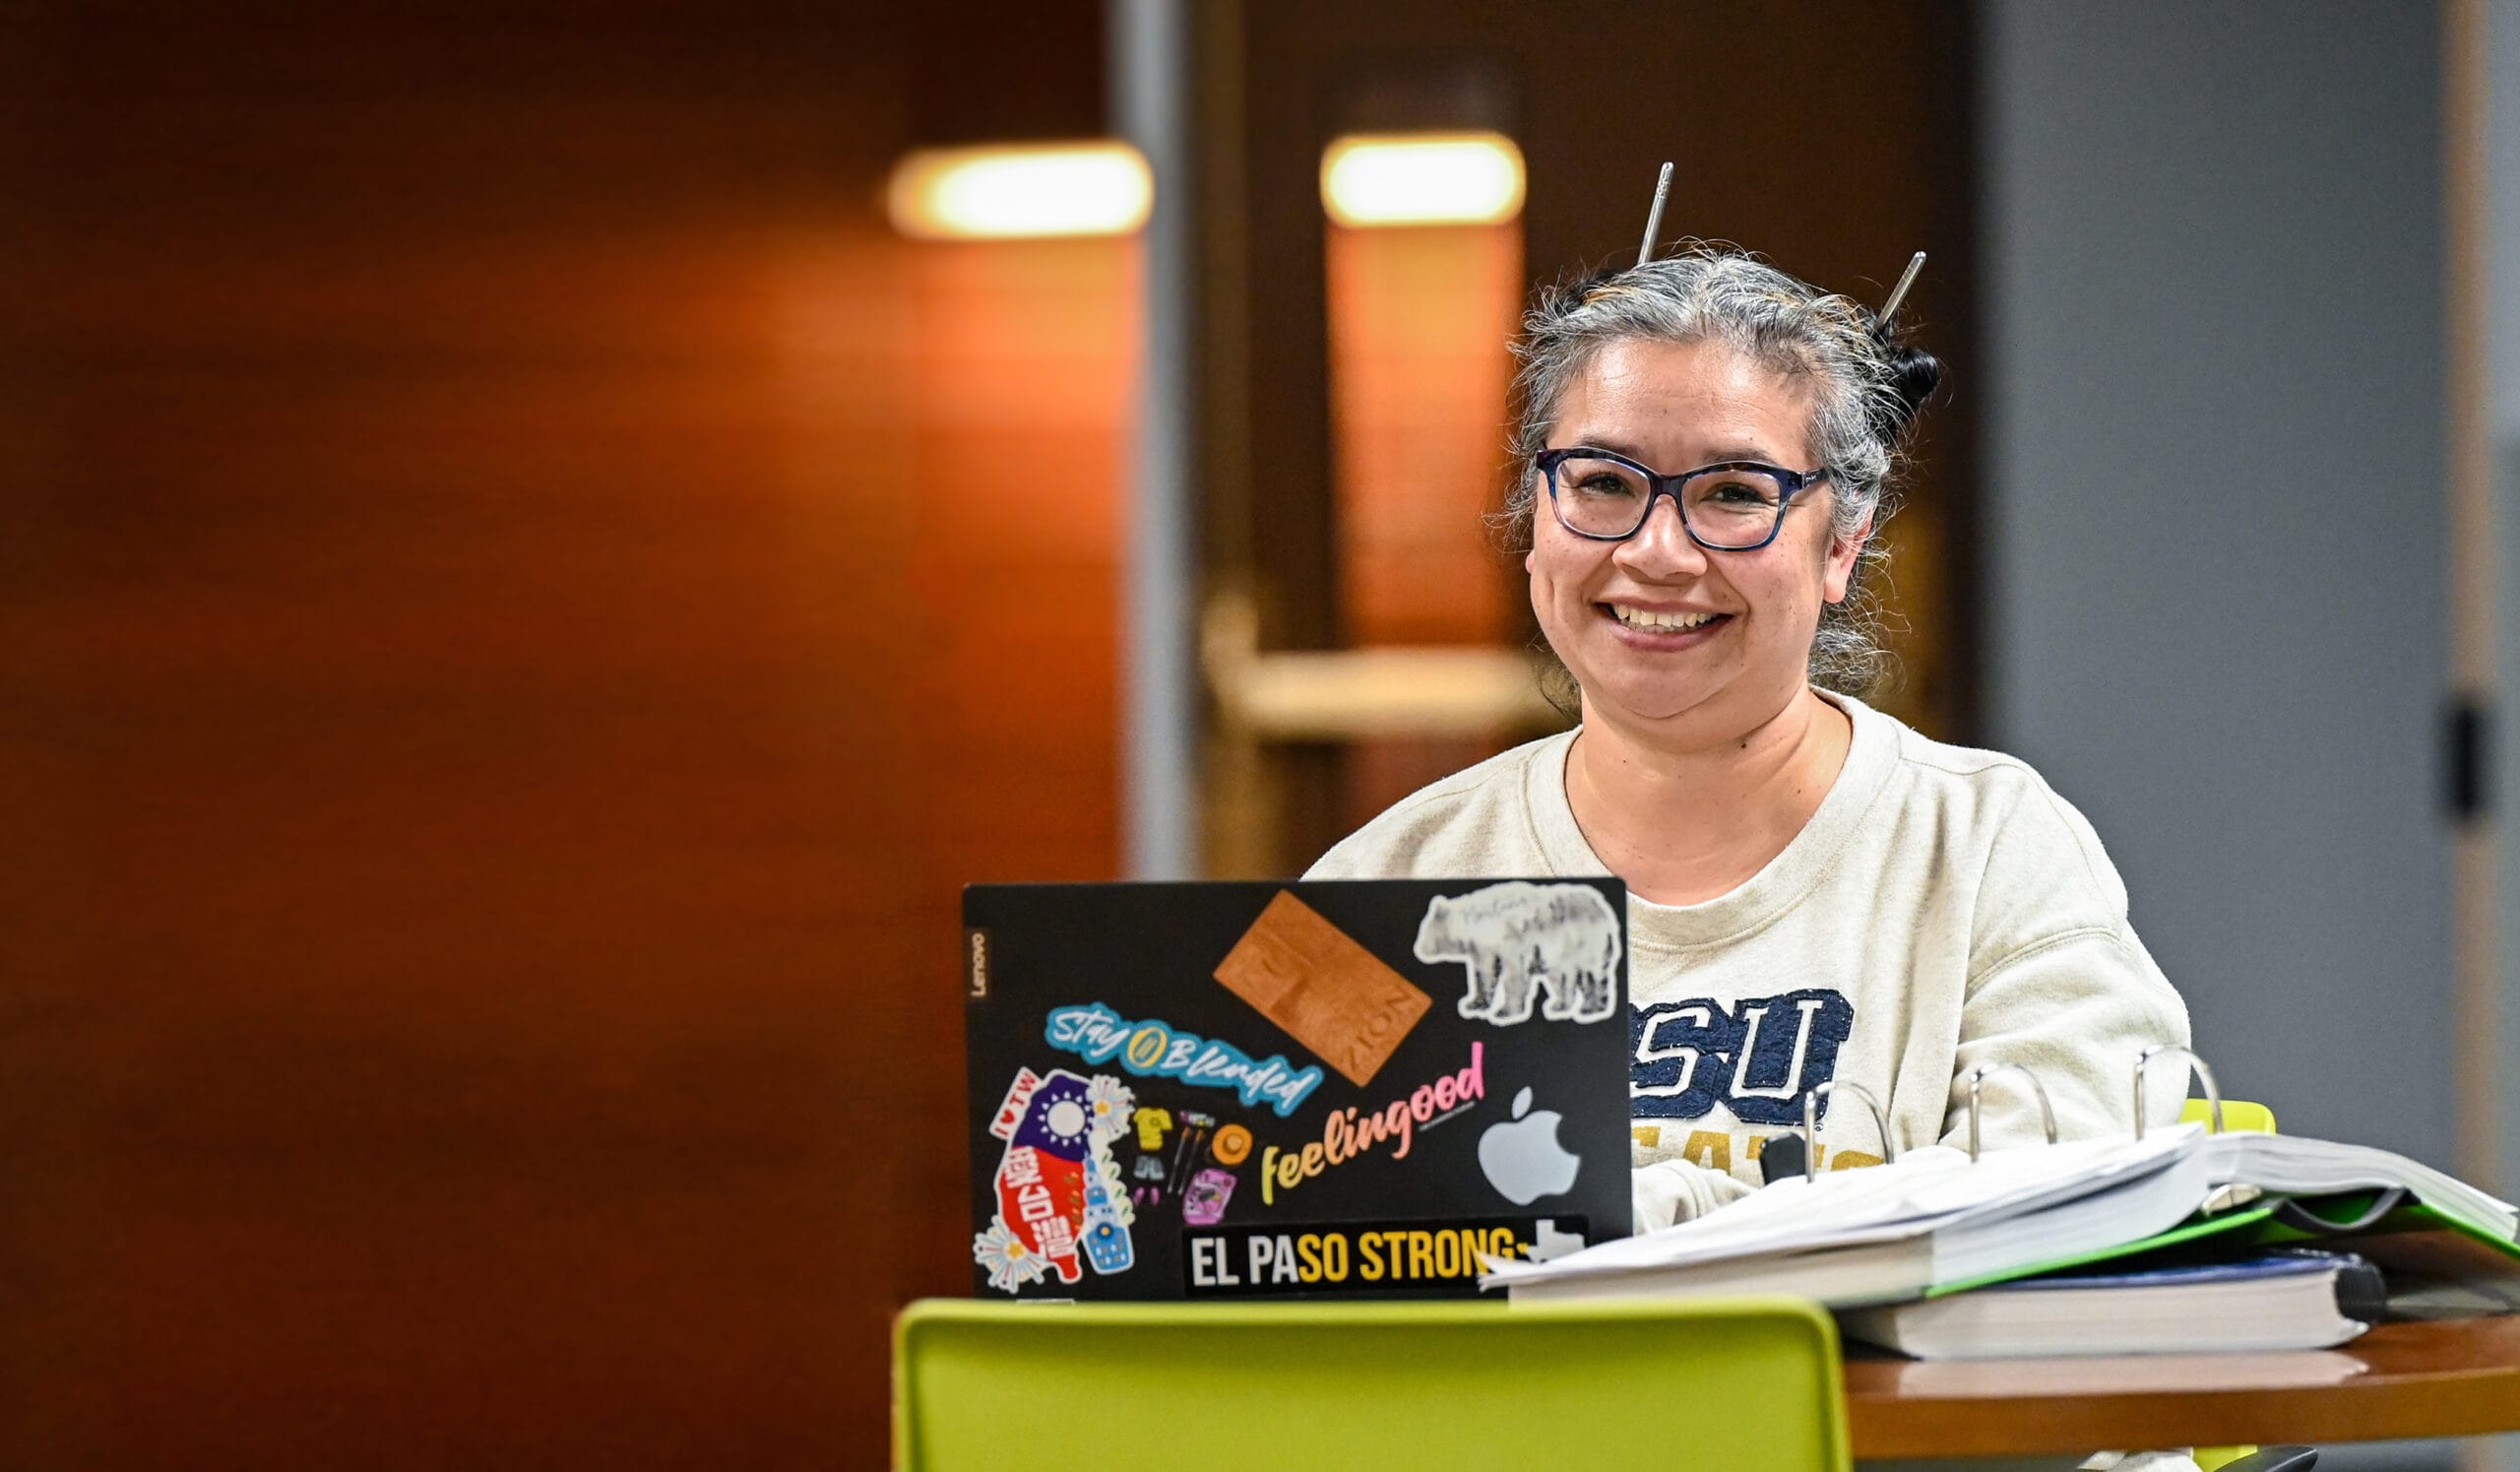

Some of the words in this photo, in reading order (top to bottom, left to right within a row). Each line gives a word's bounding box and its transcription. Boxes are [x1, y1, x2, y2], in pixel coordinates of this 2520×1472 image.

[971, 932, 986, 997] Lenovo
[1053, 1009, 1131, 1057] Stay
[1160, 1039, 1317, 1109] Blended
[1340, 986, 1418, 1073] ZION
[1629, 988, 1855, 1126] SU
[1009, 1071, 1037, 1107] TW
[1261, 1041, 1485, 1206] feelingood
[1191, 1237, 1240, 1287] EL
[1247, 1233, 1351, 1284] PASO
[1358, 1227, 1516, 1280] STRONG
